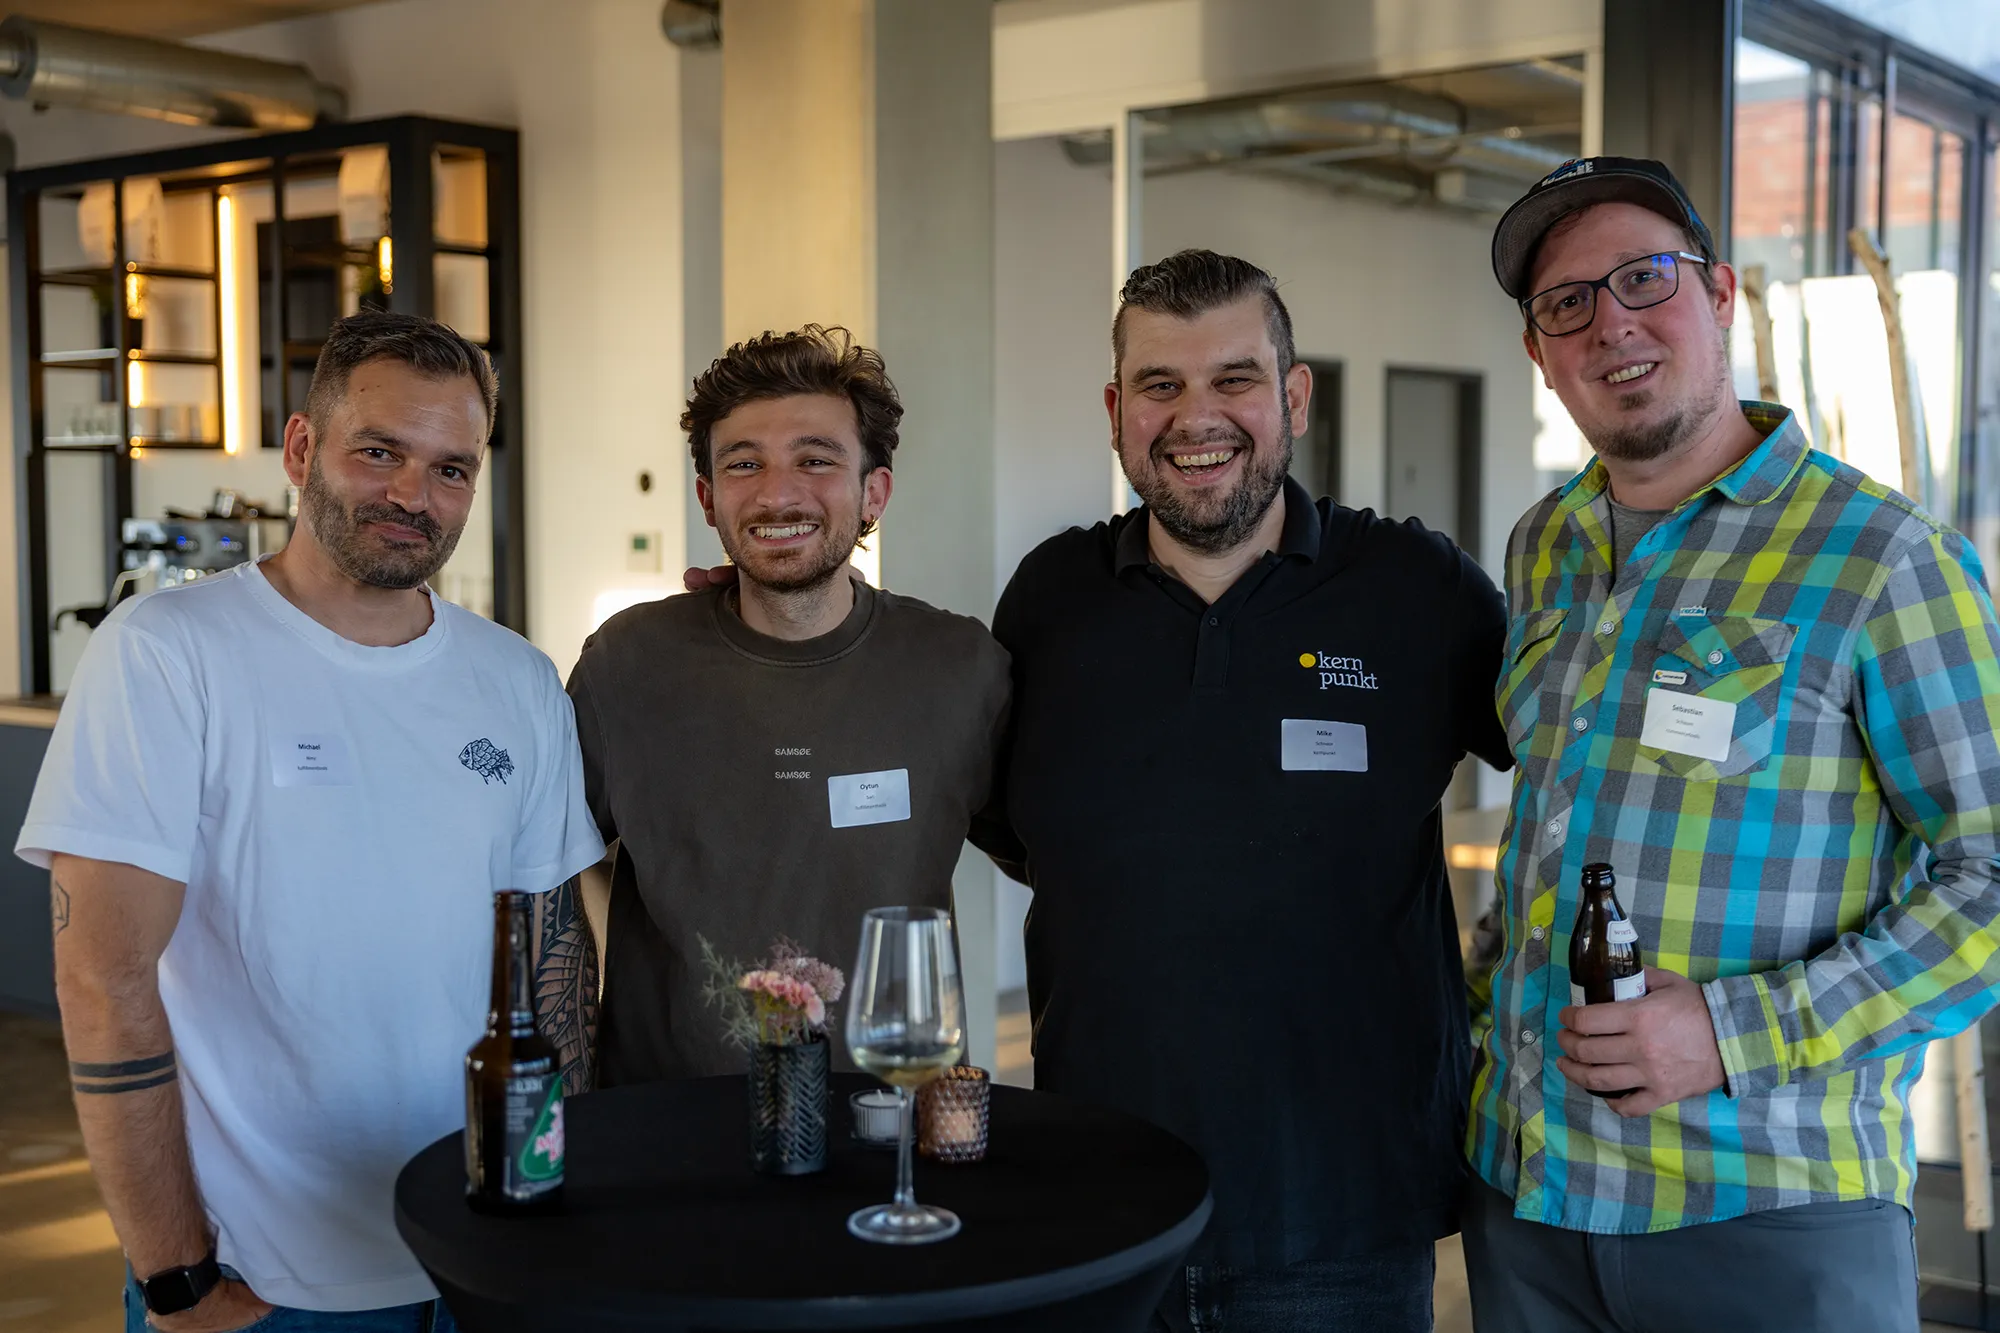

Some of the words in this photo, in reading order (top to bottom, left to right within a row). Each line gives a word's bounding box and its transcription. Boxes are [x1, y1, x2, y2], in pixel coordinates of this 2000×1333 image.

[1317, 651, 1362, 671] kern
[1319, 671, 1379, 690] punkt
[1672, 704, 1704, 716] Sebastian
[774, 748, 812, 756] SAMSØE
[774, 771, 812, 779] SAMSØE
